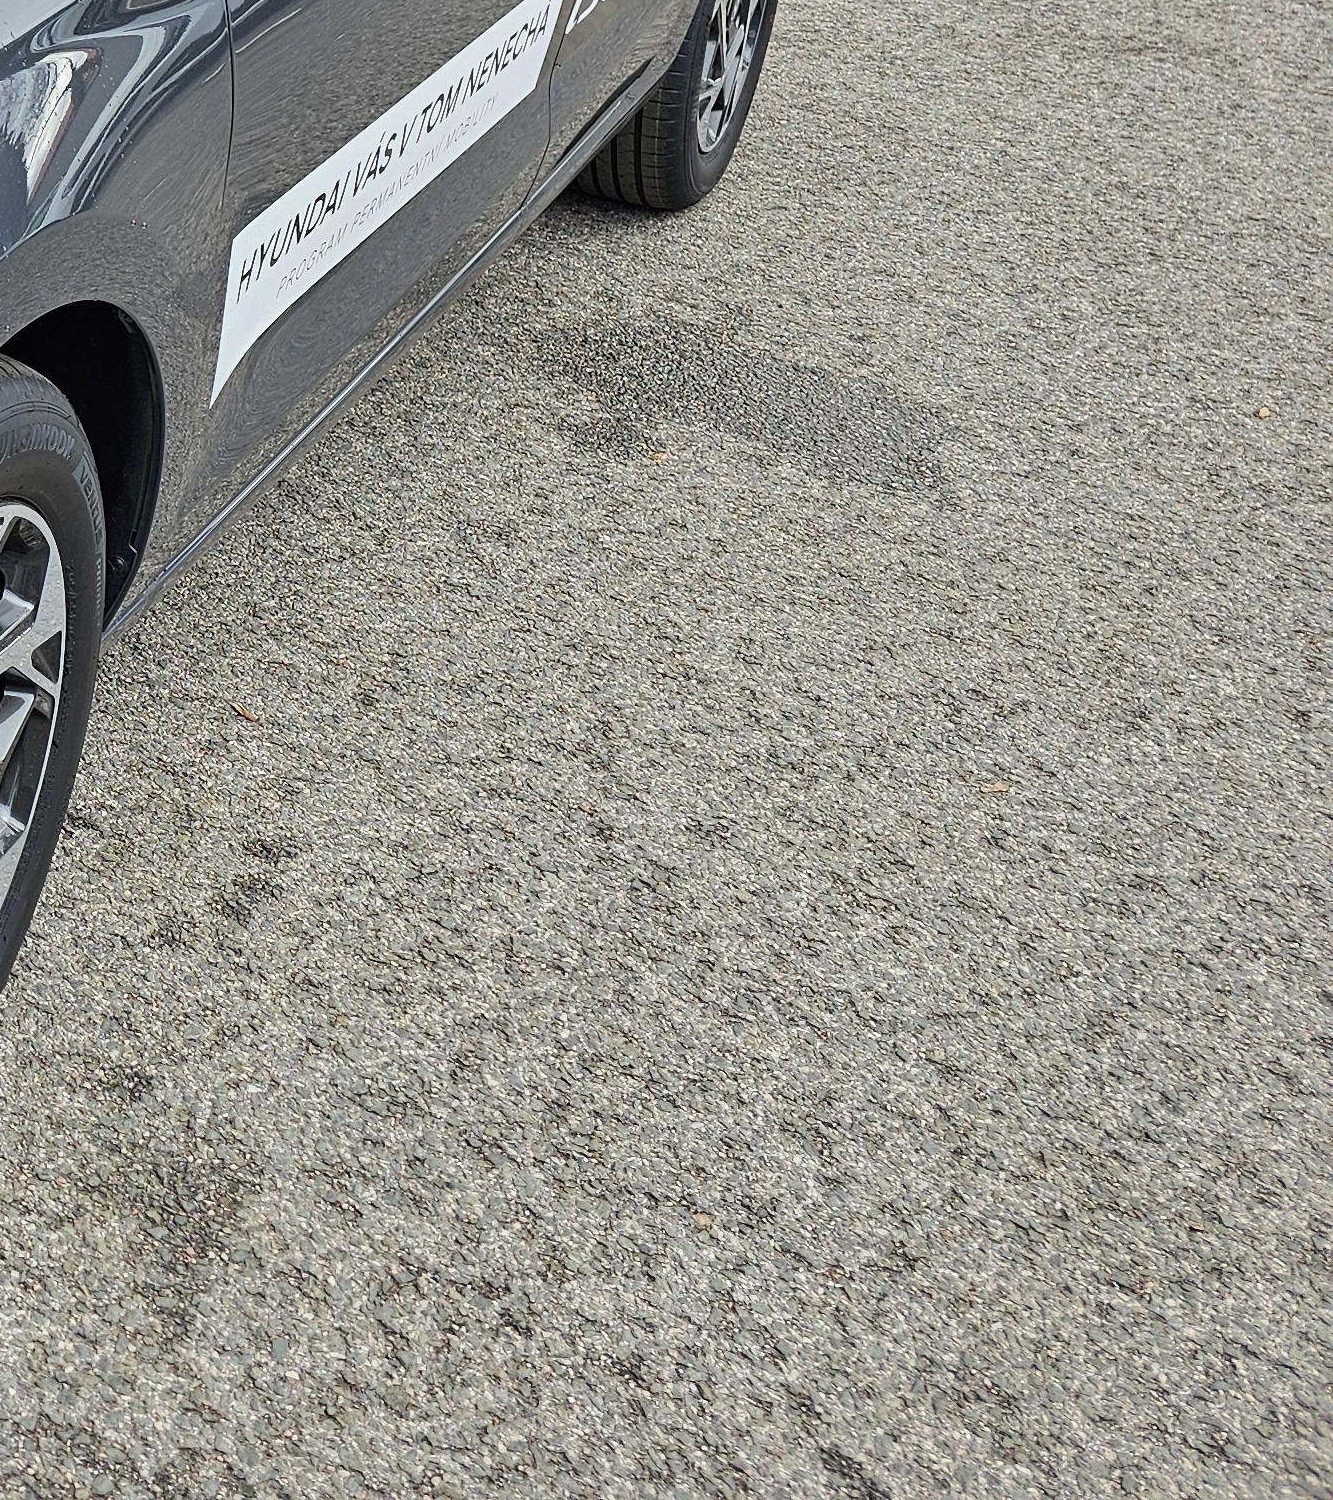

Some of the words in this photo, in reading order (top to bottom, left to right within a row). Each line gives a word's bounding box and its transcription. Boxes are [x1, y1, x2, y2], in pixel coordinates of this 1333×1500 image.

[236, 170, 351, 304] HYUNDAI
[353, 131, 398, 197] VÁS
[398, 114, 419, 158] V
[416, 76, 464, 144] TOM
[276, 222, 349, 299] PROGRAM
[445, 92, 500, 150] MOBILITY
